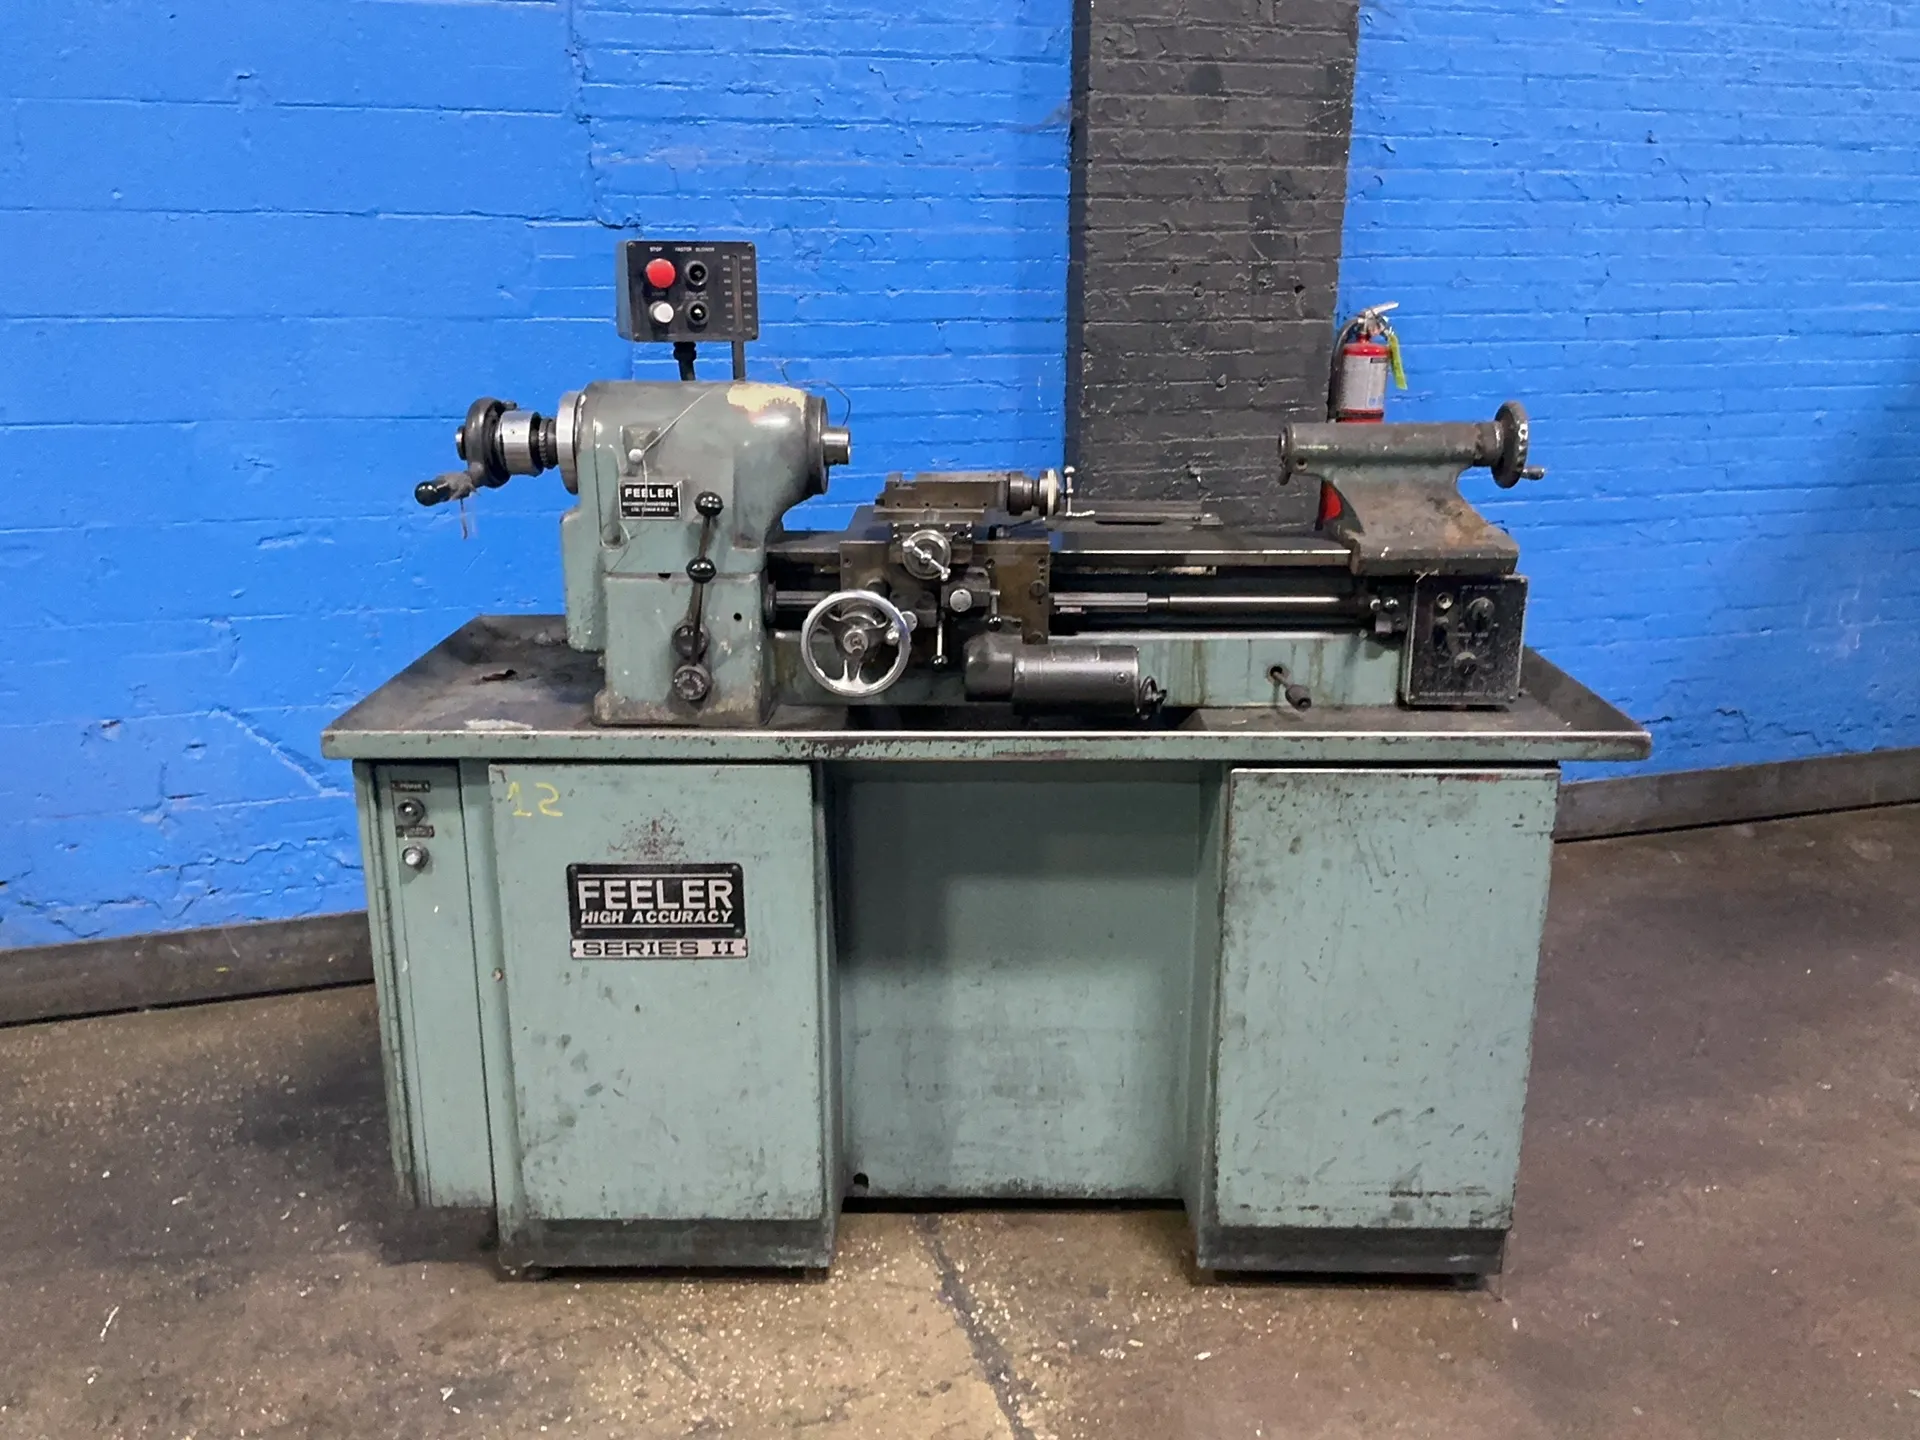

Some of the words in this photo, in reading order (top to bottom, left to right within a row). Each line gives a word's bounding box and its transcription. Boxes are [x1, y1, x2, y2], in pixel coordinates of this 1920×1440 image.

[625, 488, 673, 498] FEELER
[507, 782, 563, 816] 12
[578, 880, 733, 910] FEELER
[580, 910, 624, 923] HIGH
[631, 909, 733, 923] ACCURACY
[582, 941, 699, 956] SERIES
[711, 941, 735, 955] II
